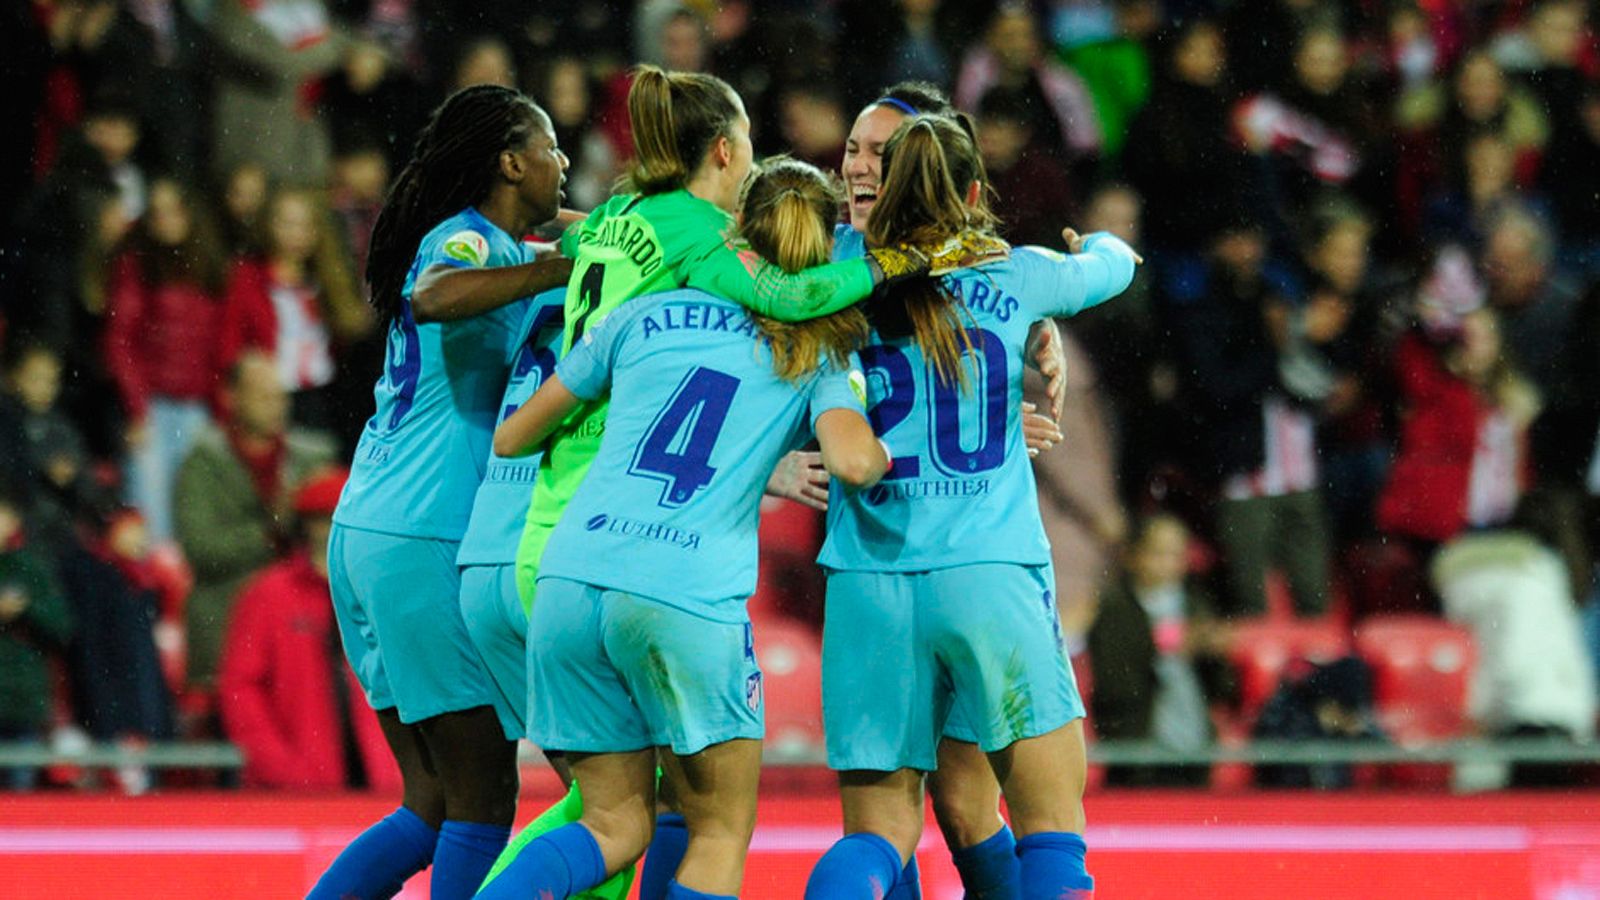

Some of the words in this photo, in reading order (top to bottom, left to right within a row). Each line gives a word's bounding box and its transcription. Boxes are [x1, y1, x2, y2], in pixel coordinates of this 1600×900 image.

[642, 304, 767, 344] ALEIXA
[948, 276, 1019, 323] ARIS
[626, 366, 741, 509] 4
[857, 328, 1008, 480] 20
